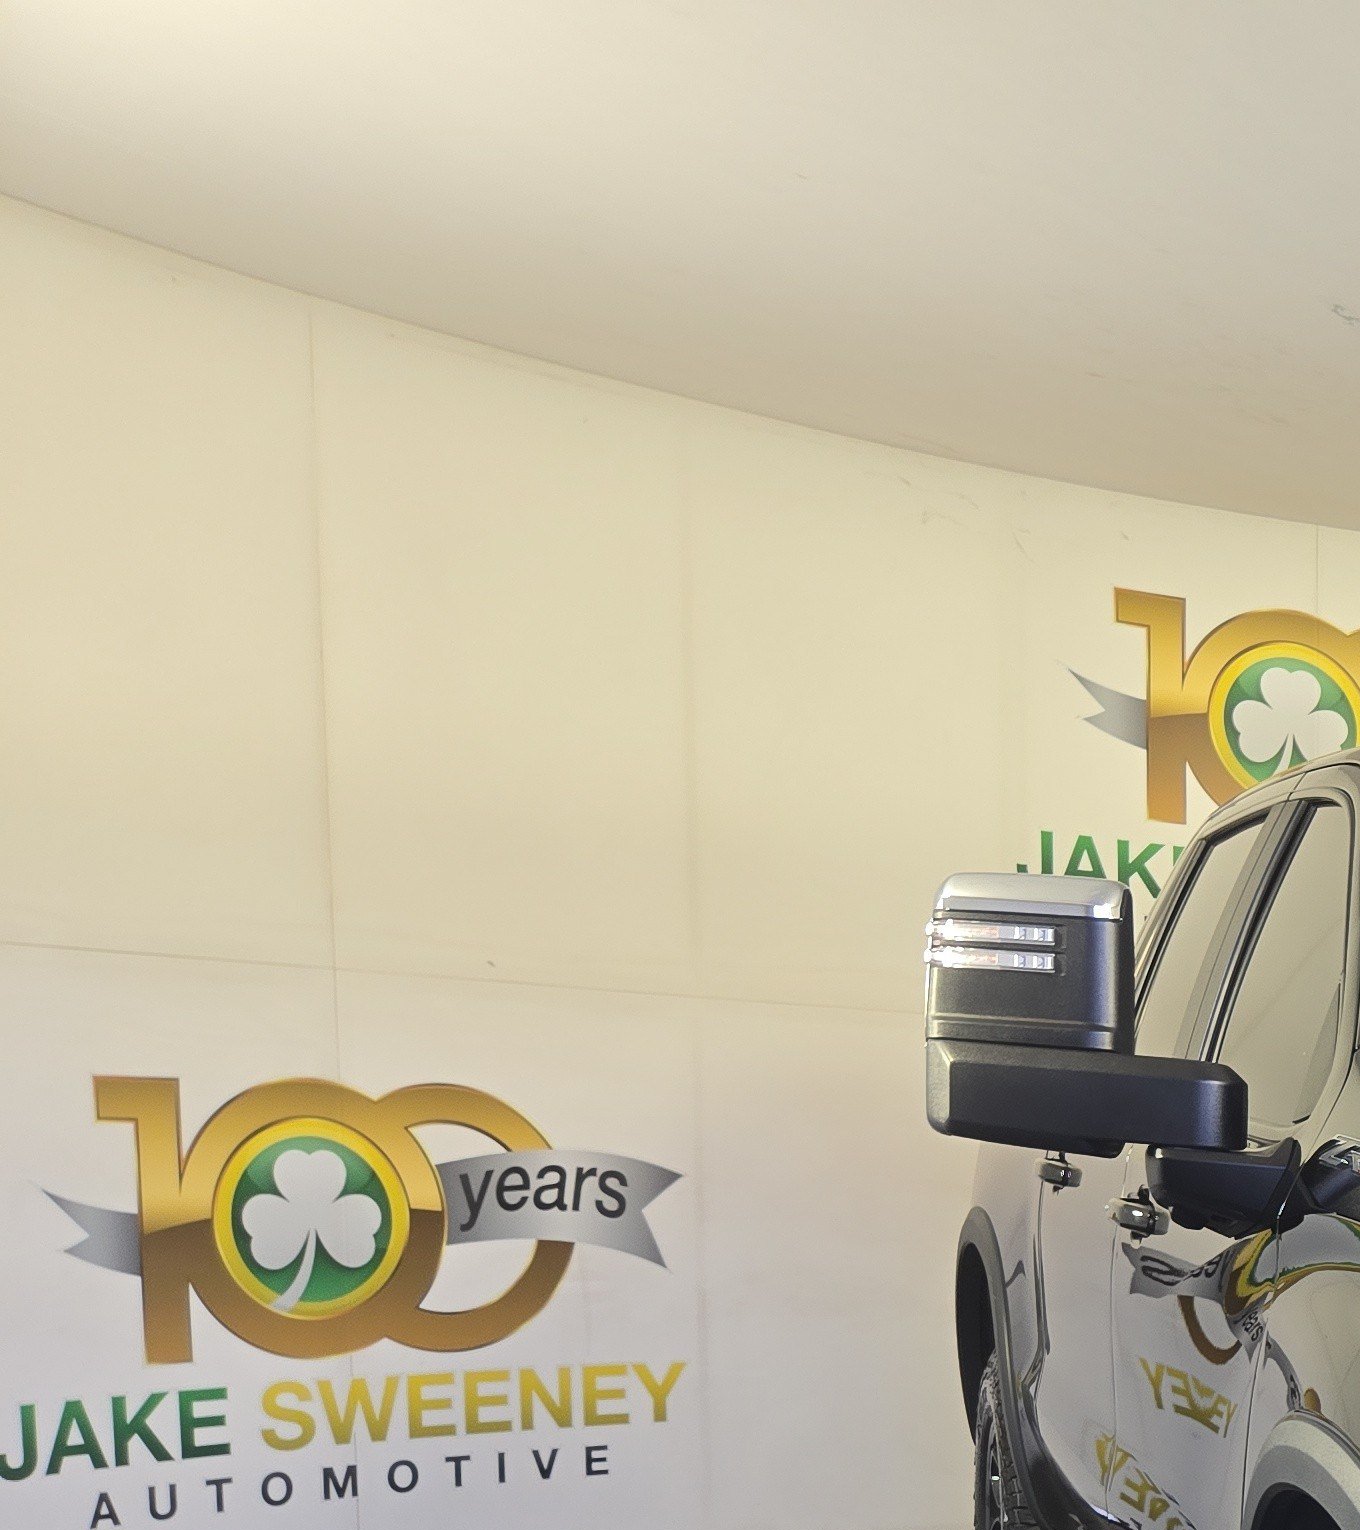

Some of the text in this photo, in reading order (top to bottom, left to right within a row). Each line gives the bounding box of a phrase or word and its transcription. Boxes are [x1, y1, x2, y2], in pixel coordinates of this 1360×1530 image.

[1017, 830, 1185, 899] JAK
[459, 1162, 629, 1233] years
[0, 1361, 688, 1482] JAKE SWEENEY
[90, 1445, 610, 1530] AUTOMOTIVE
